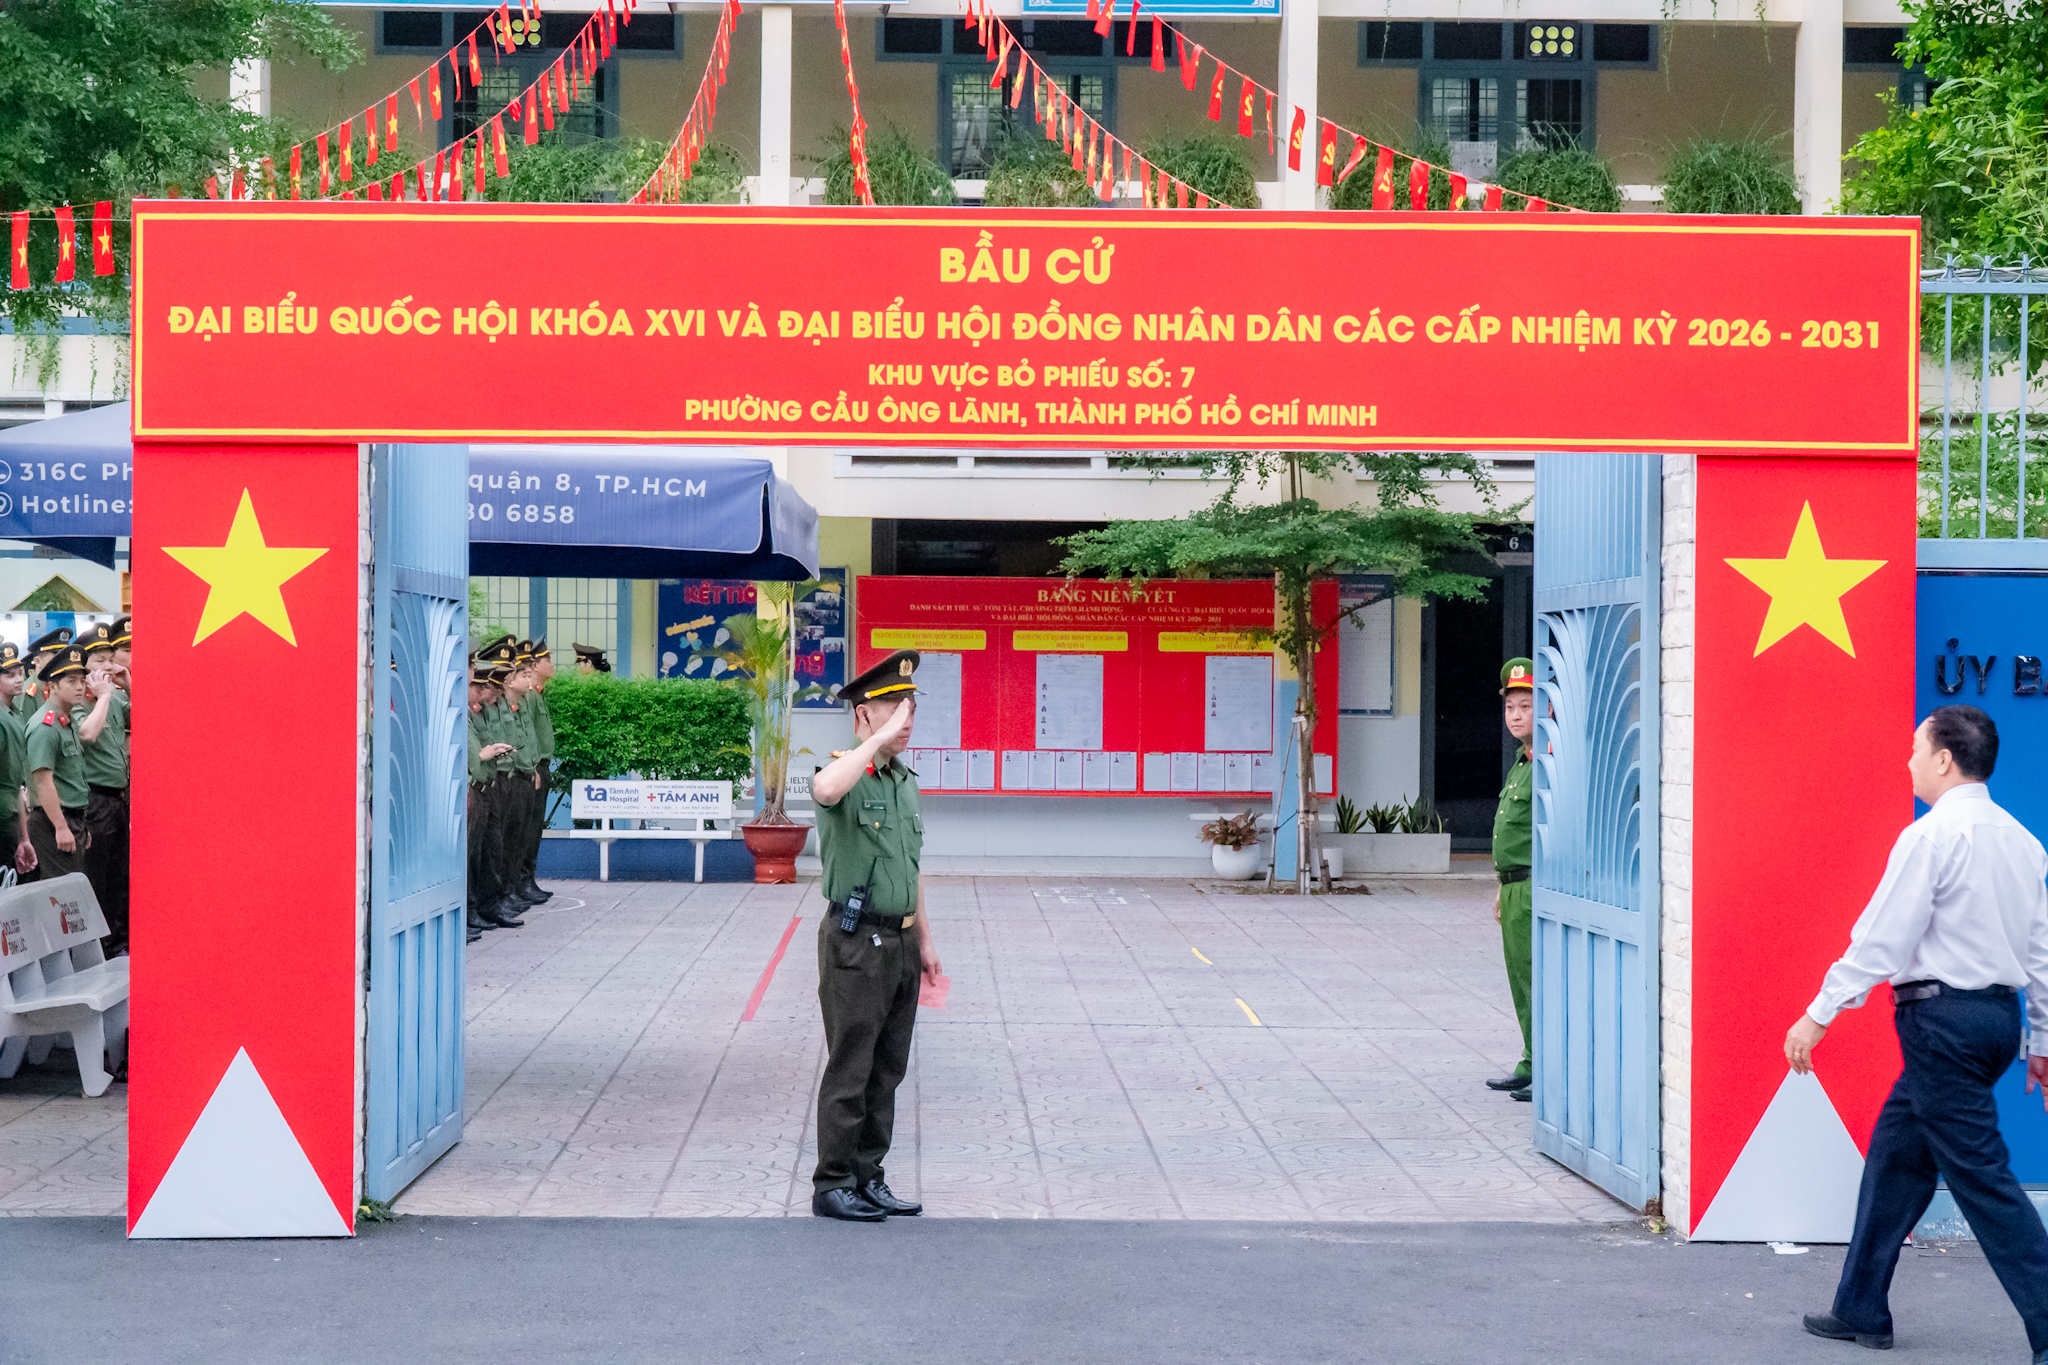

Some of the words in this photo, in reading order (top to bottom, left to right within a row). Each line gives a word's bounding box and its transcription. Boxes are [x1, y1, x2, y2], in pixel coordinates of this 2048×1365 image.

[941, 230, 1029, 283] BẦU
[1046, 236, 1114, 284] CỬ
[168, 306, 230, 341] ĐẠI
[244, 291, 317, 334] BIỂU
[330, 295, 441, 335] QUỐC
[454, 300, 517, 343] HỘI
[531, 301, 634, 336] KHÓA
[645, 309, 704, 336] XVI
[717, 302, 767, 337] VÀ
[778, 311, 839, 346] ĐẠI
[853, 297, 924, 339] BIỂU
[938, 305, 1000, 347] HỘI
[1013, 299, 1121, 341] ĐỒNG
[1134, 307, 1234, 342] NHÂN
[1247, 307, 1321, 342] DÂN
[1334, 307, 1414, 343] CÁC
[1426, 304, 1500, 344] CẤP
[1512, 310, 1620, 352] NHIỆM
[1634, 310, 1677, 346] KỲ
[1689, 318, 1771, 347] 2026
[1802, 320, 1879, 349] 2031
[869, 365, 922, 386] KHU
[931, 362, 988, 392] VỰC
[998, 358, 1035, 387] BỎ
[1044, 358, 1118, 388] PHIẾU
[1127, 358, 1171, 388] SỐ:
[1181, 367, 1195, 388] 7
[685, 394, 802, 421] PHƯỜNG
[810, 390, 869, 423] CẦU
[877, 395, 940, 423] ÔNG
[950, 397, 1027, 427] LÃNH,
[1036, 396, 1126, 425] THÀNH
[1135, 395, 1192, 425] PHỐ
[1201, 393, 1241, 425] HỒ
[1250, 398, 1300, 426] CHÍ
[1307, 404, 1377, 426] MINH
[20, 463, 87, 481] 316C
[468, 471, 541, 494] quận
[555, 473, 581, 495] 8,
[595, 475, 707, 498] TP.HCM
[22, 493, 132, 514] Hotline:
[506, 504, 575, 524] 6858
[1509, 536, 1519, 550] 6
[35, 620, 41, 628] 5
[1936, 637, 1998, 695] ỦY
[2013, 655, 2048, 696] B
[584, 784, 607, 802] ta
[609, 796, 639, 804] Hospital
[624, 787, 639, 795] Anh
[657, 790, 686, 802] TÂM
[689, 793, 719, 802] ANH
